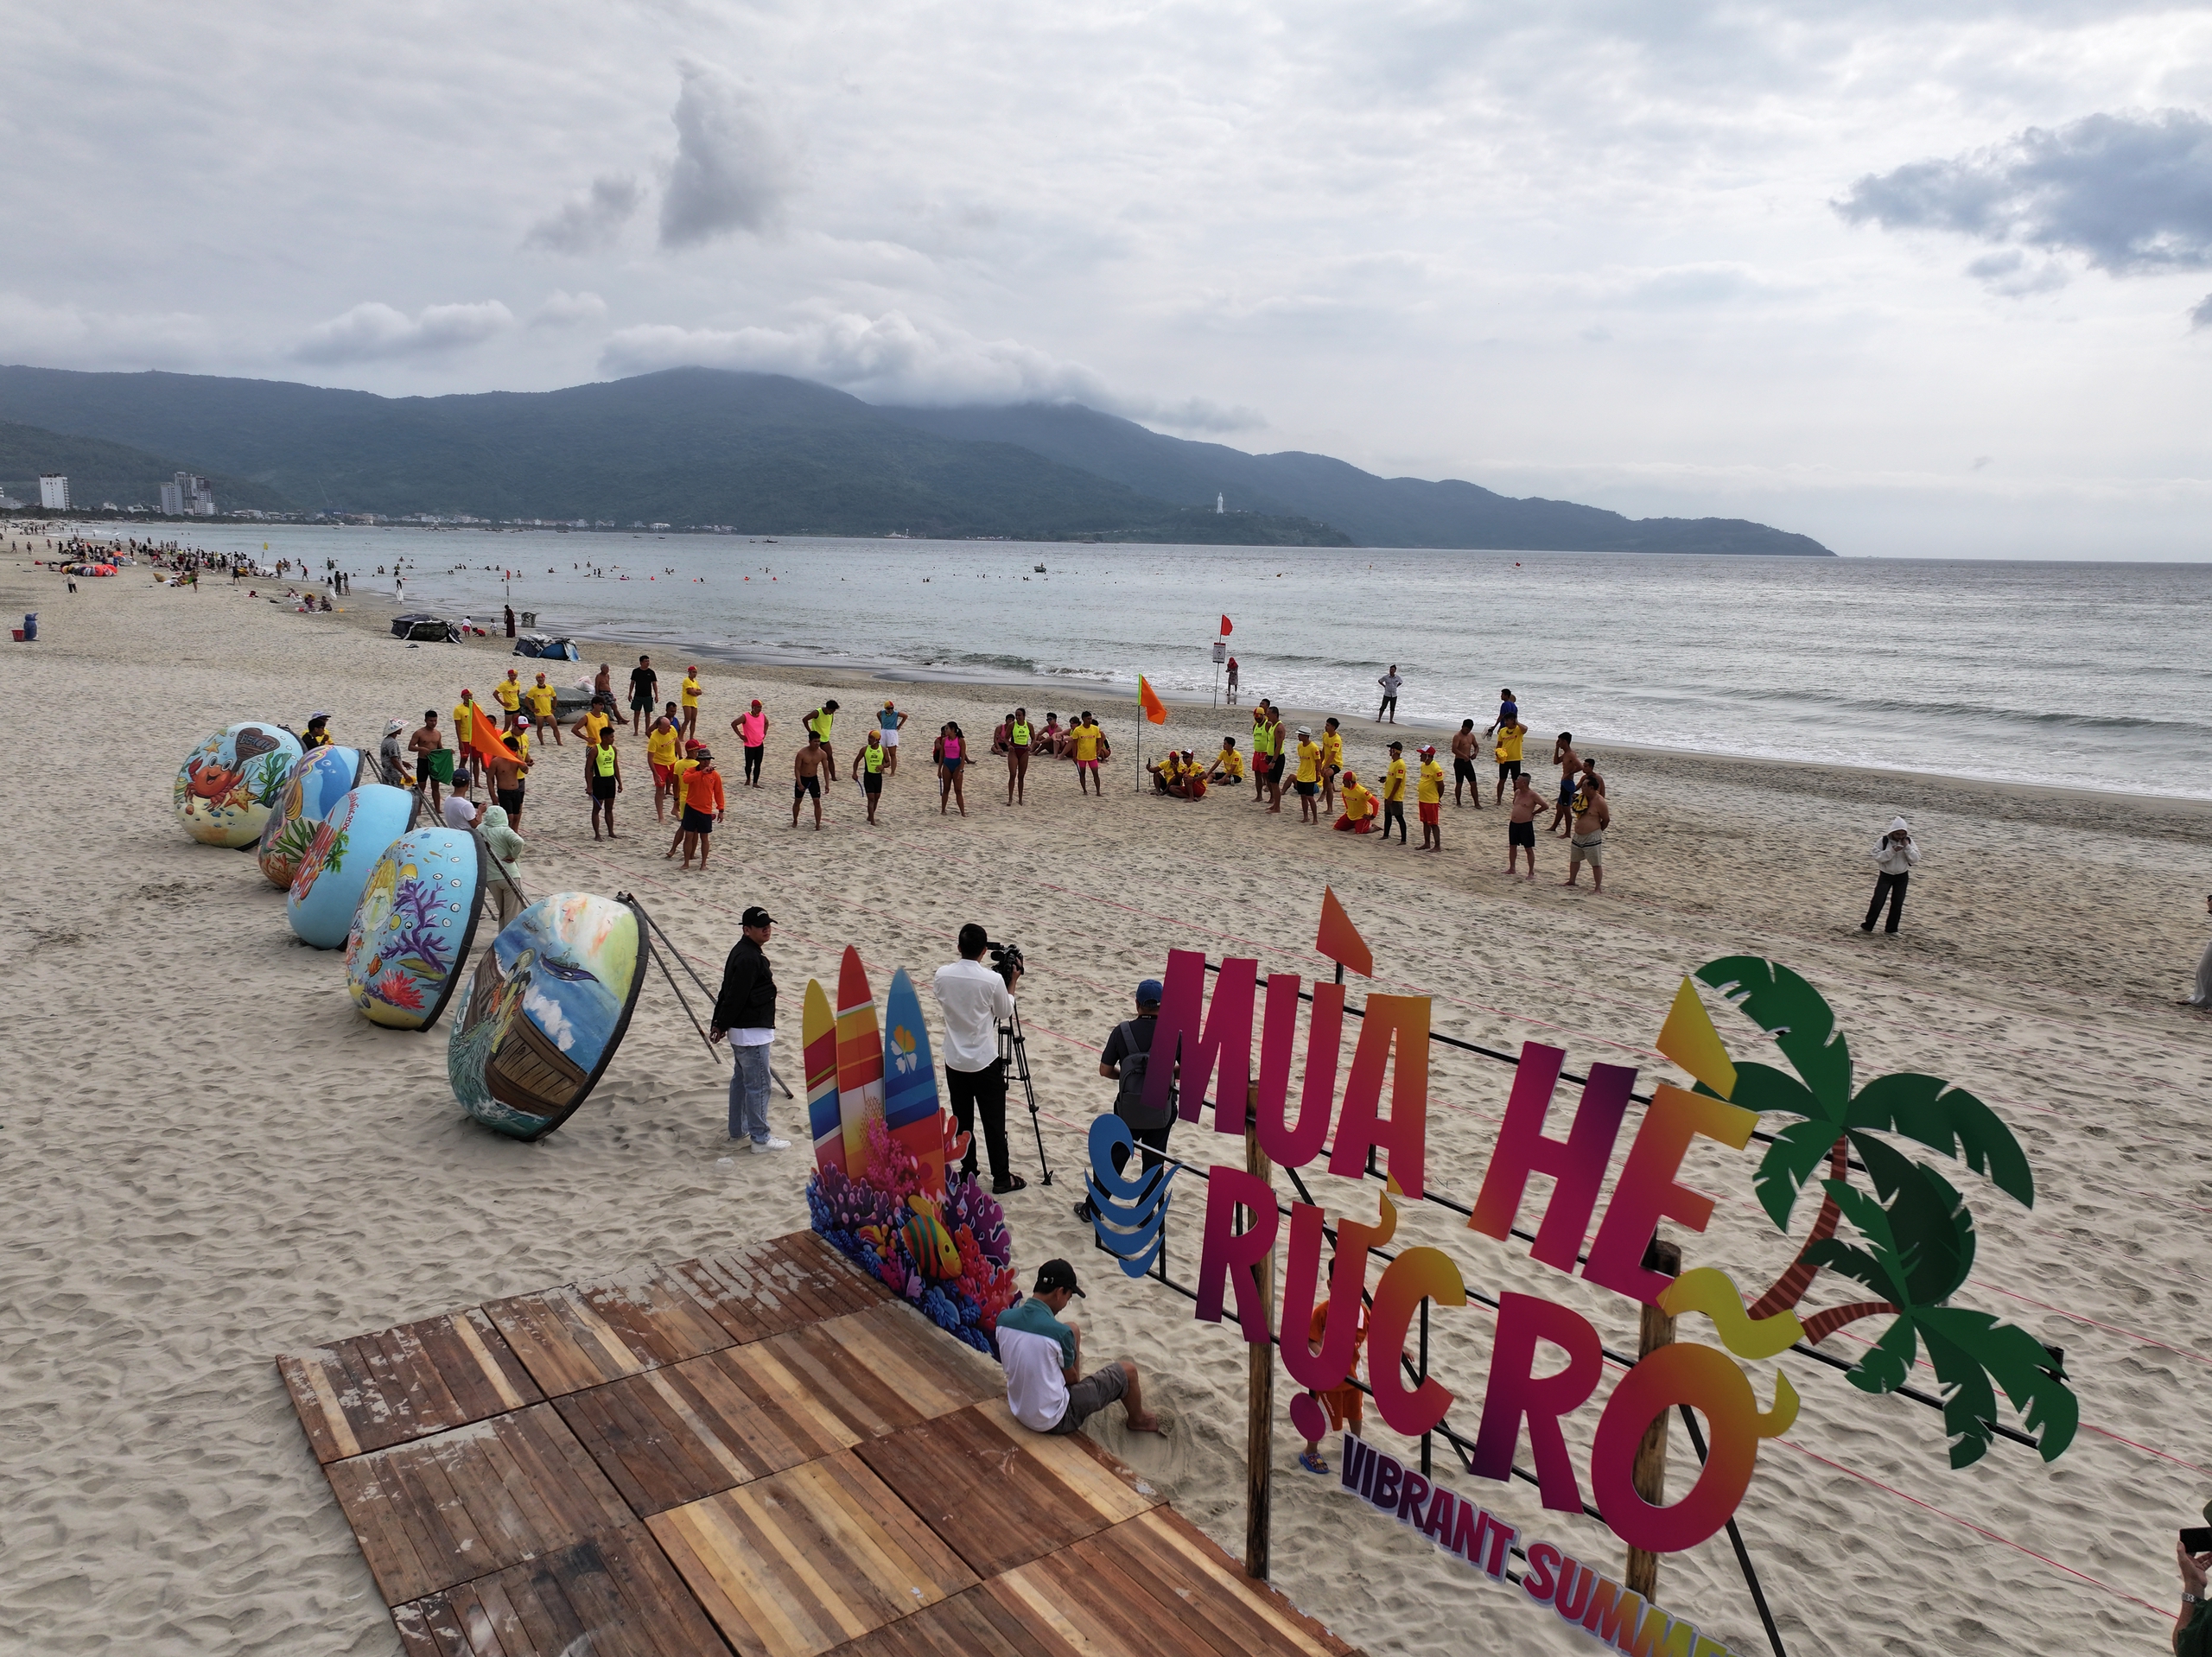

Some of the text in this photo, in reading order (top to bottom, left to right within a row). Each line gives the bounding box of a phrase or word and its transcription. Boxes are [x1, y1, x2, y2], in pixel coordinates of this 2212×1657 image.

[239, 734, 271, 751] BEACH
[1140, 884, 1760, 1310] MÙA HÈ
[1195, 1165, 1807, 1552] RỰC RỠ
[1341, 1432, 1738, 1657] VIBRANT SUMM
